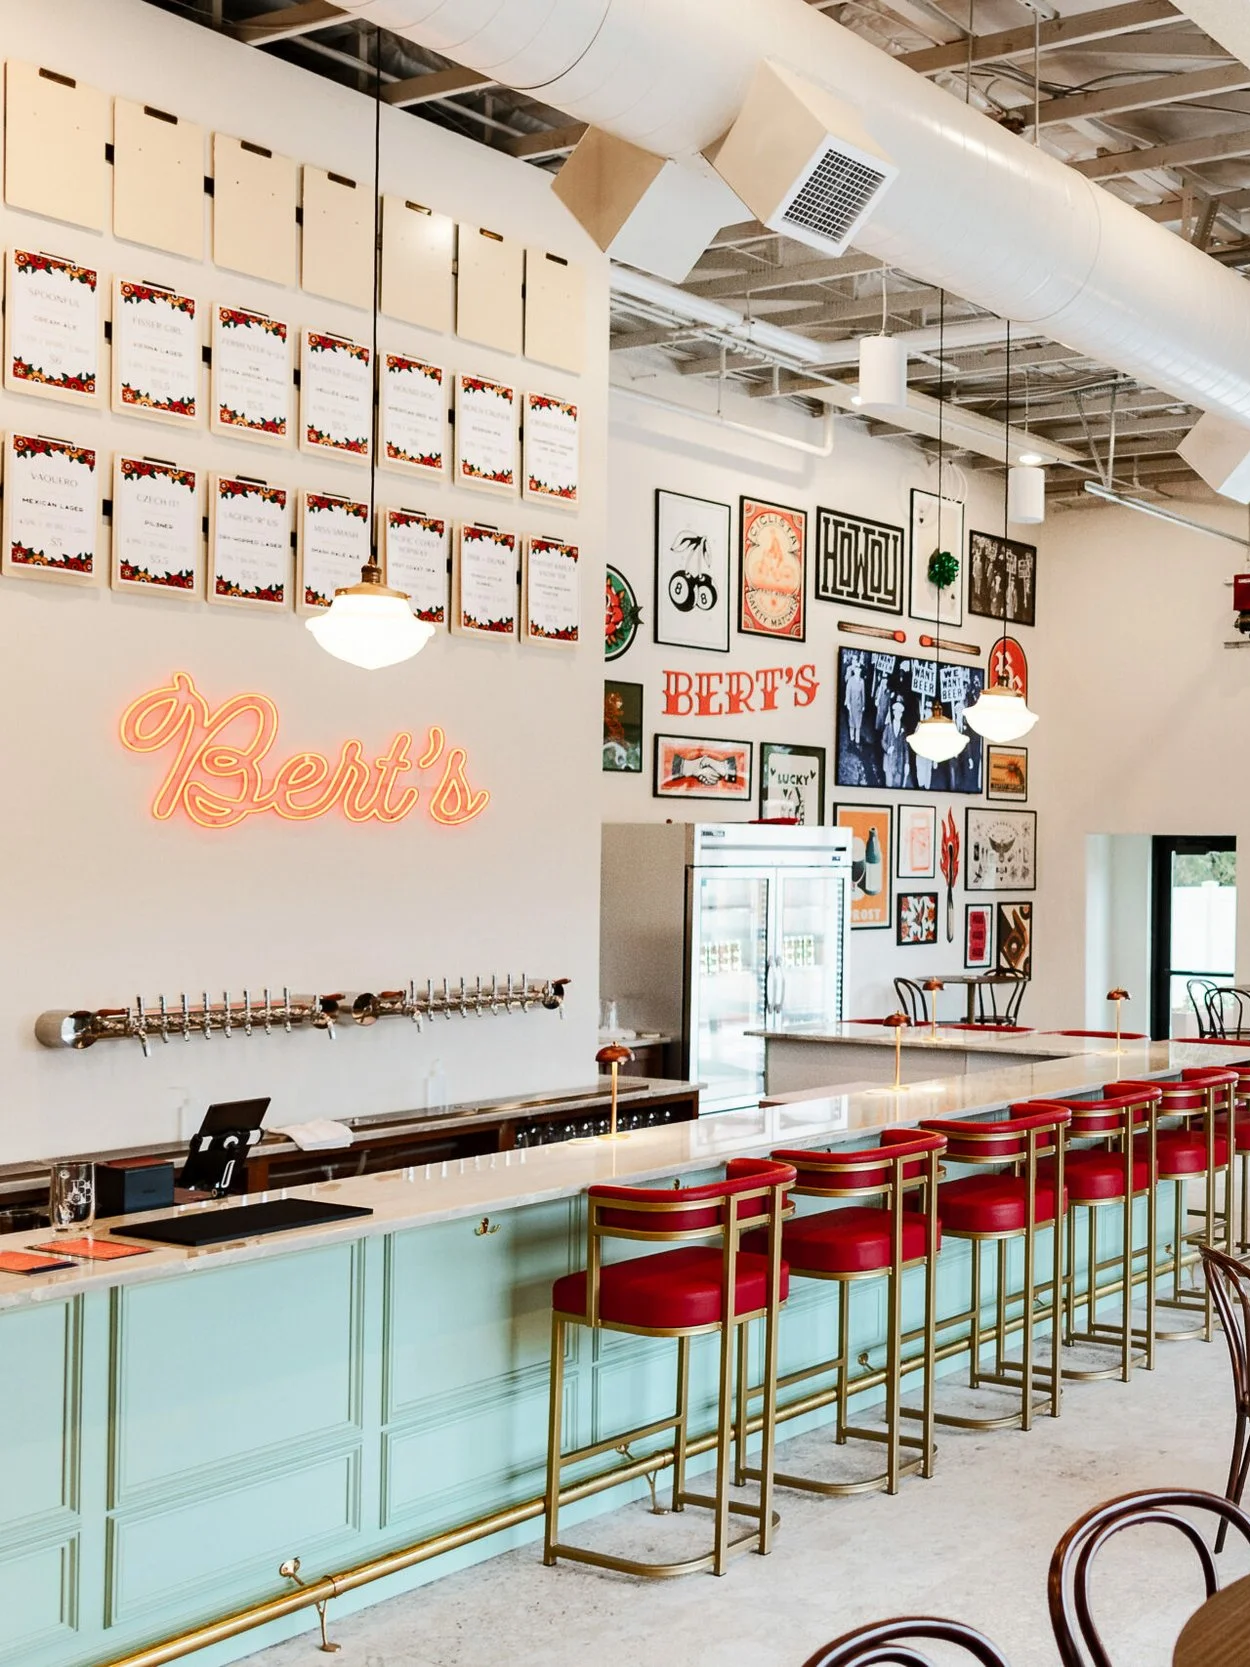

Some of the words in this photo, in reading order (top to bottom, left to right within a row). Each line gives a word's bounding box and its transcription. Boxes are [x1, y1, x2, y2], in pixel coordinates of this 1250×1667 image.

[31, 471, 79, 488] VAQUERO
[21, 497, 58, 509] MEXICAN
[59, 504, 85, 513] LAGER
[750, 514, 798, 545] CICLISTA
[821, 516, 899, 606] HOWDY
[675, 582, 682, 595] 8
[701, 593, 707, 605] 8
[914, 667, 935, 683] WANT
[943, 669, 960, 679] WE
[662, 664, 820, 716] BERT'S
[913, 679, 935, 693] BEER
[942, 679, 962, 689] WANT
[942, 688, 963, 700] BEER
[120, 672, 490, 828] Bert's
[778, 773, 810, 786] LUCKY
[851, 908, 881, 921] ROST
